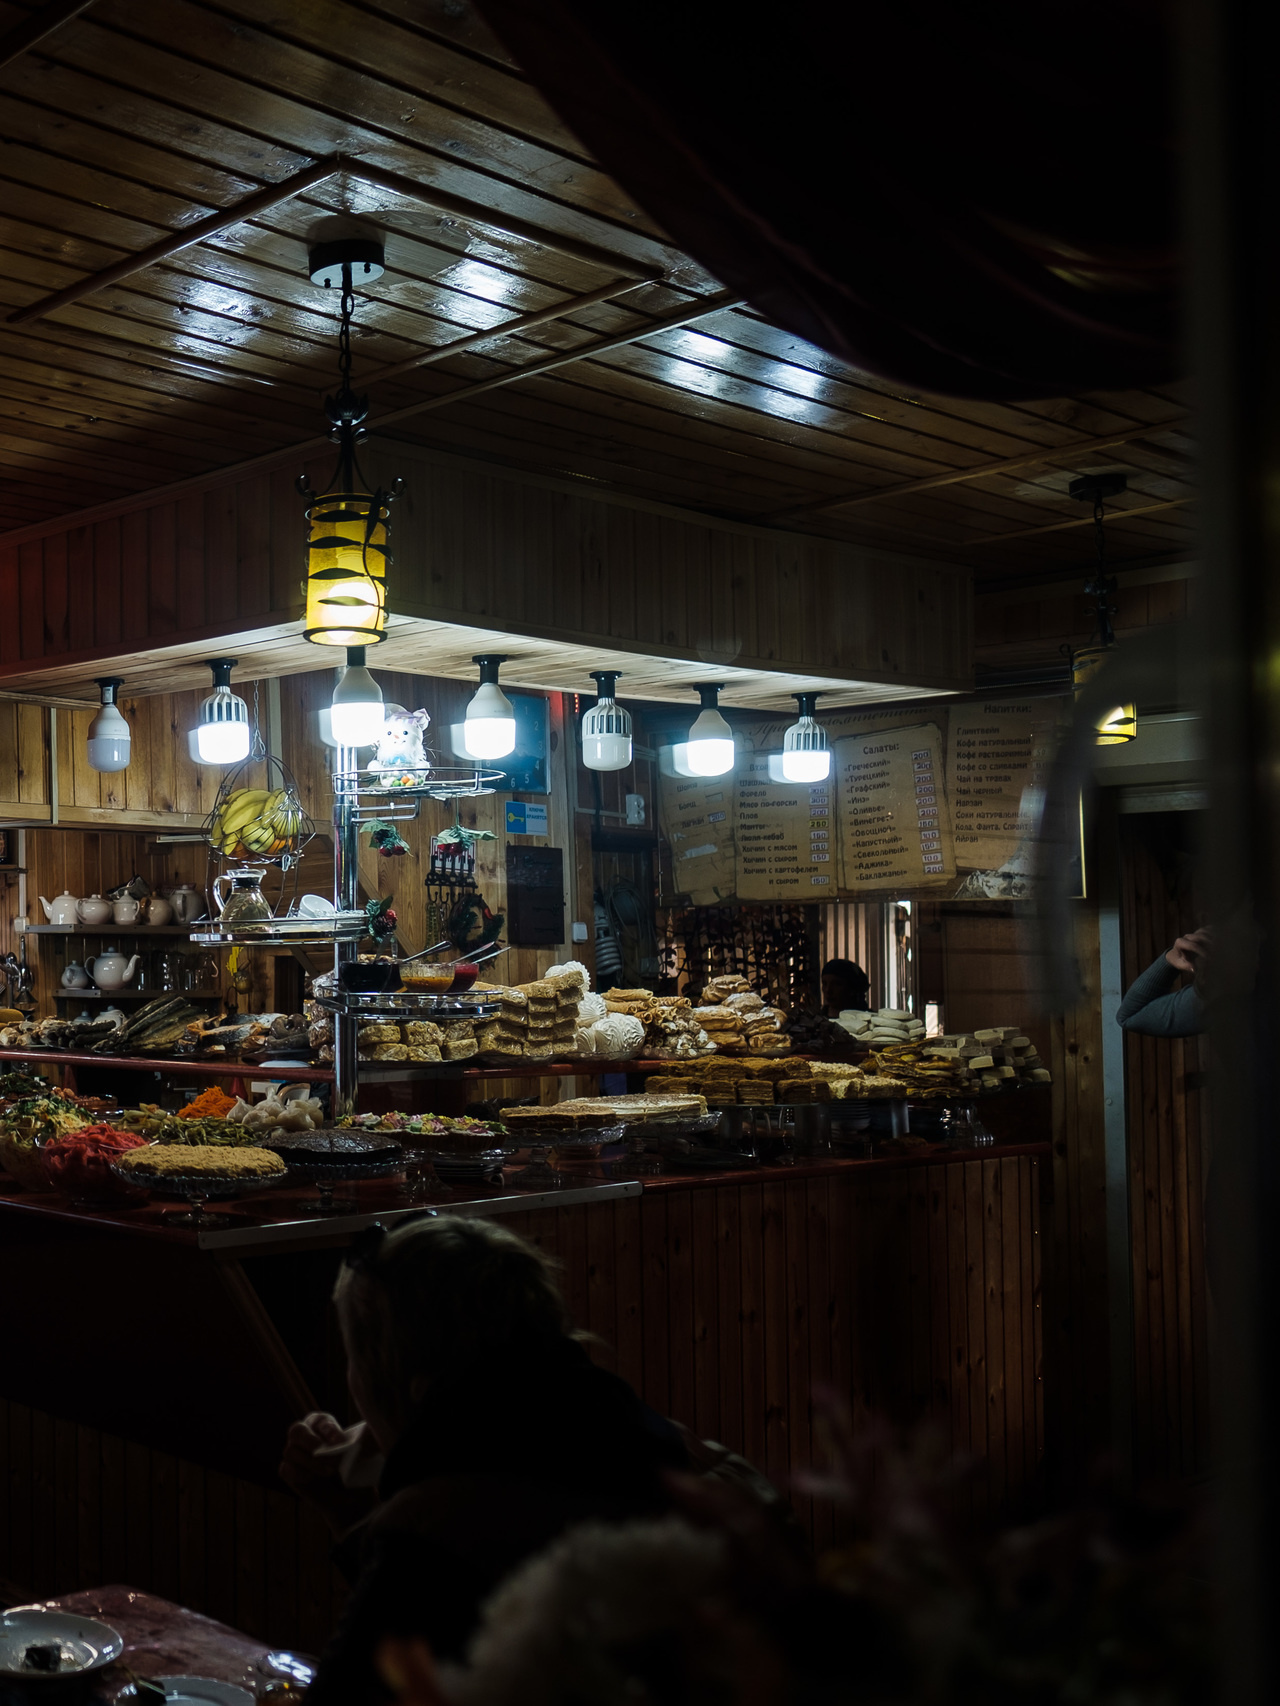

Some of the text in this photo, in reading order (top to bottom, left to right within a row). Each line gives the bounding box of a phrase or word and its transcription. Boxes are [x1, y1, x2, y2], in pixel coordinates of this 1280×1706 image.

[984, 704, 1032, 714] Напитки:
[956, 737, 1031, 748] Кофе натуральный
[863, 743, 900, 755] Салаты:
[913, 752, 929, 760] 200
[956, 749, 1032, 760] Кофе растворимый
[956, 763, 976, 772] Кофе
[956, 774, 971, 783] Чай
[956, 786, 971, 795] Чай
